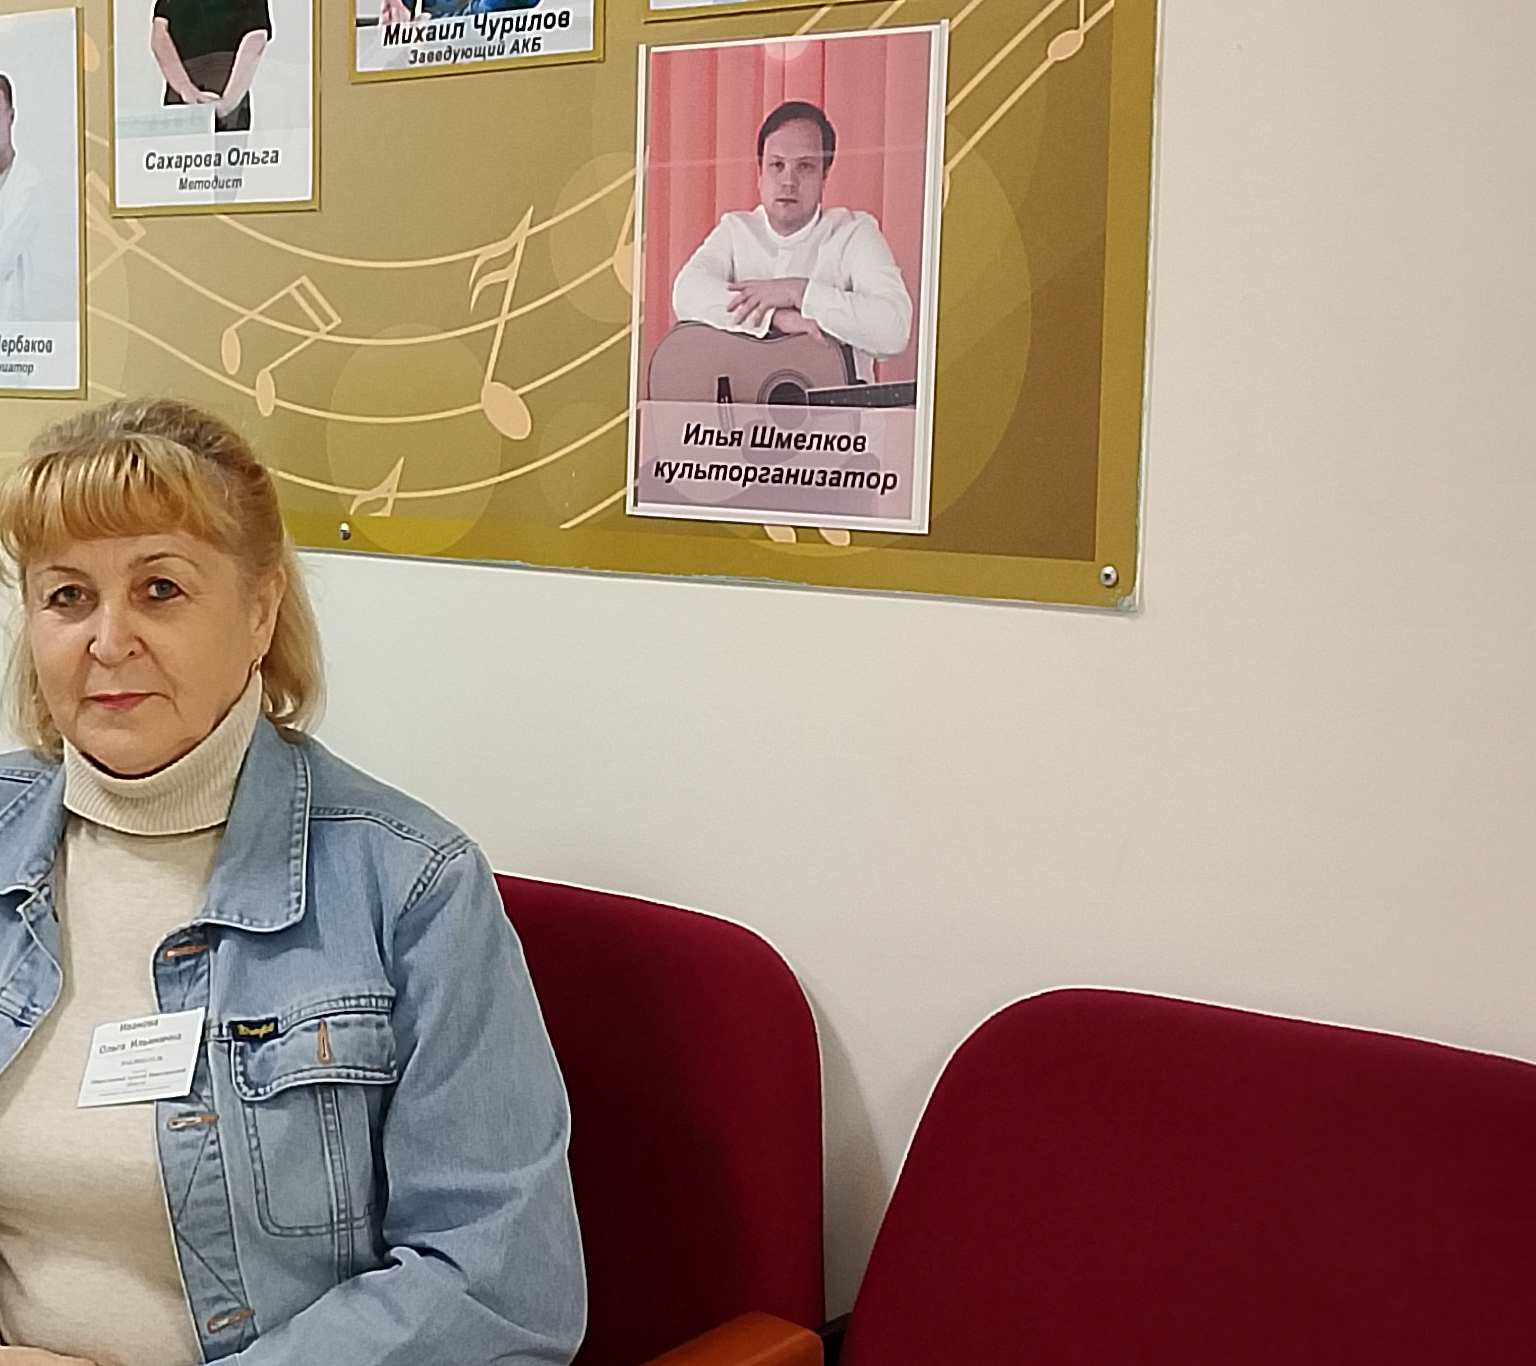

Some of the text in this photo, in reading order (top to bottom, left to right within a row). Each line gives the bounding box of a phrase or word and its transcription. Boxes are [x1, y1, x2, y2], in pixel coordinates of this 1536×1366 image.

[383, 10, 571, 46] Михаил Чурилов
[409, 37, 542, 65] Заведующий АКБ
[145, 148, 279, 172] Сахарова Ольга
[178, 175, 242, 190] Методист
[683, 423, 867, 452] Илья Шмелков
[654, 460, 897, 495] культорганизатор
